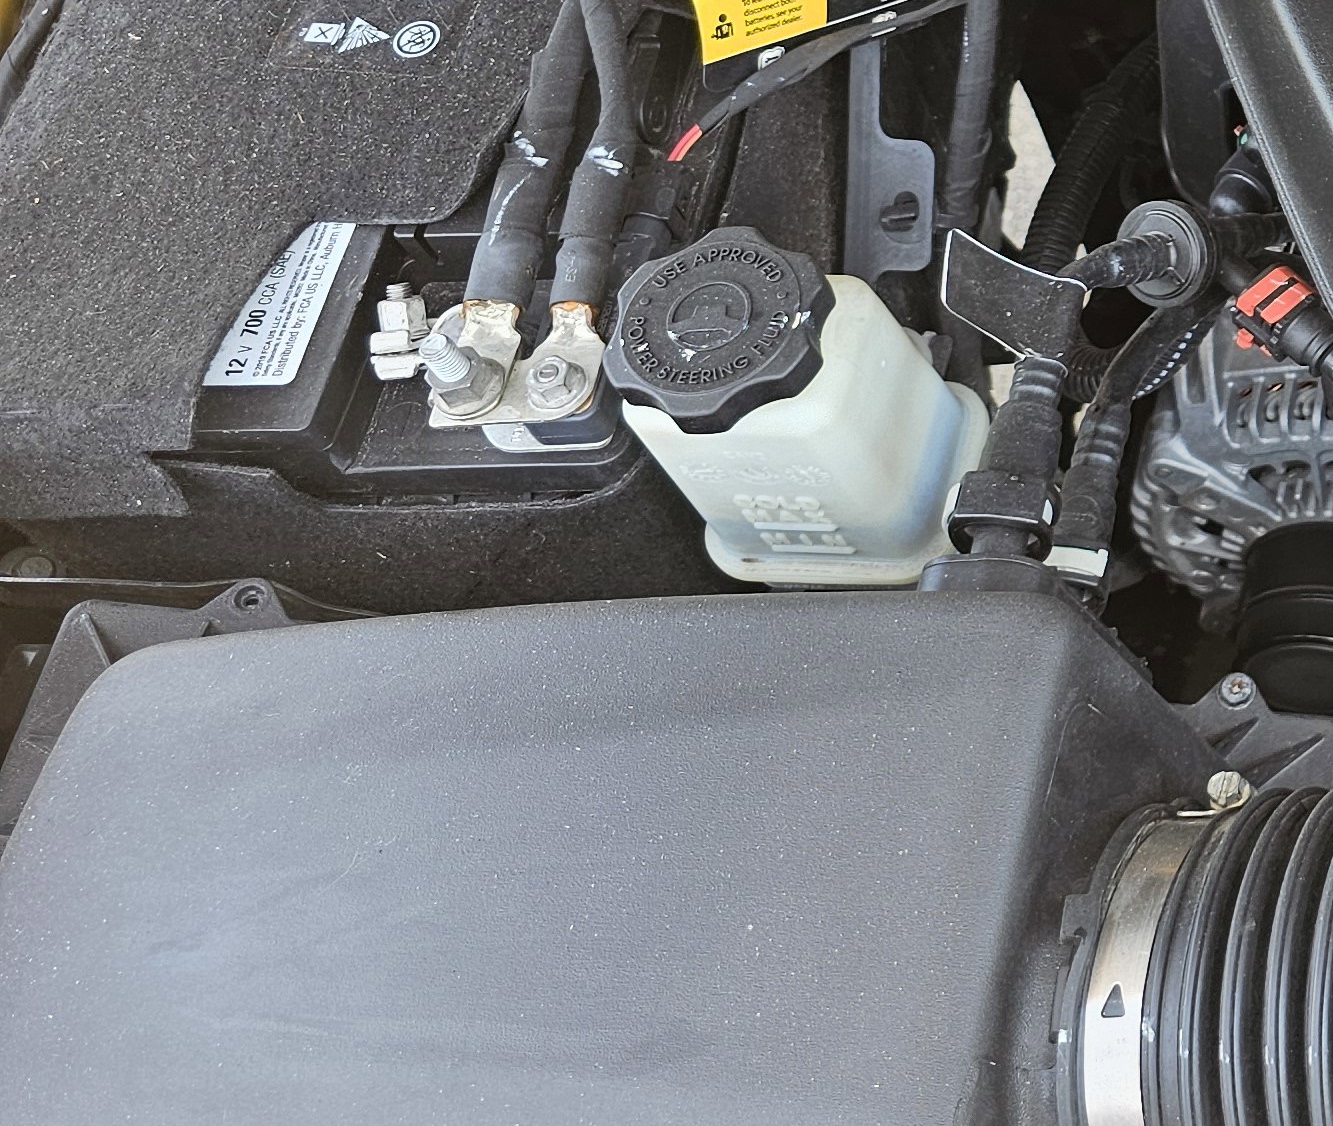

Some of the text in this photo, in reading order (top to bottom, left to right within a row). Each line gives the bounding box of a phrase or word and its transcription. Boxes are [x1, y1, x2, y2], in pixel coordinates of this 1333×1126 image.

[742, 0, 751, 7] To
[744, 1, 780, 17] disconnect
[787, 5, 803, 15] your
[746, 22, 781, 36] authorized
[324, 231, 339, 260] Auburn
[311, 264, 329, 281] LLC,
[653, 247, 783, 289] USE APPROVED
[307, 283, 318, 296] US
[298, 296, 313, 313] FCA
[225, 358, 248, 376] 12
[240, 310, 267, 337] 700
[258, 282, 280, 305] CCA
[270, 250, 296, 278] (SAE)
[272, 316, 282, 329] LLC
[291, 316, 306, 332] by:
[267, 329, 276, 340] US
[262, 339, 273, 355] FCA
[272, 332, 299, 377] Distributed
[628, 310, 786, 385] POWER STEERING FLUID
[257, 355, 267, 371] 2019
[733, 493, 821, 511] COLD
[741, 508, 833, 523] MAX
[759, 531, 848, 546] MIN
